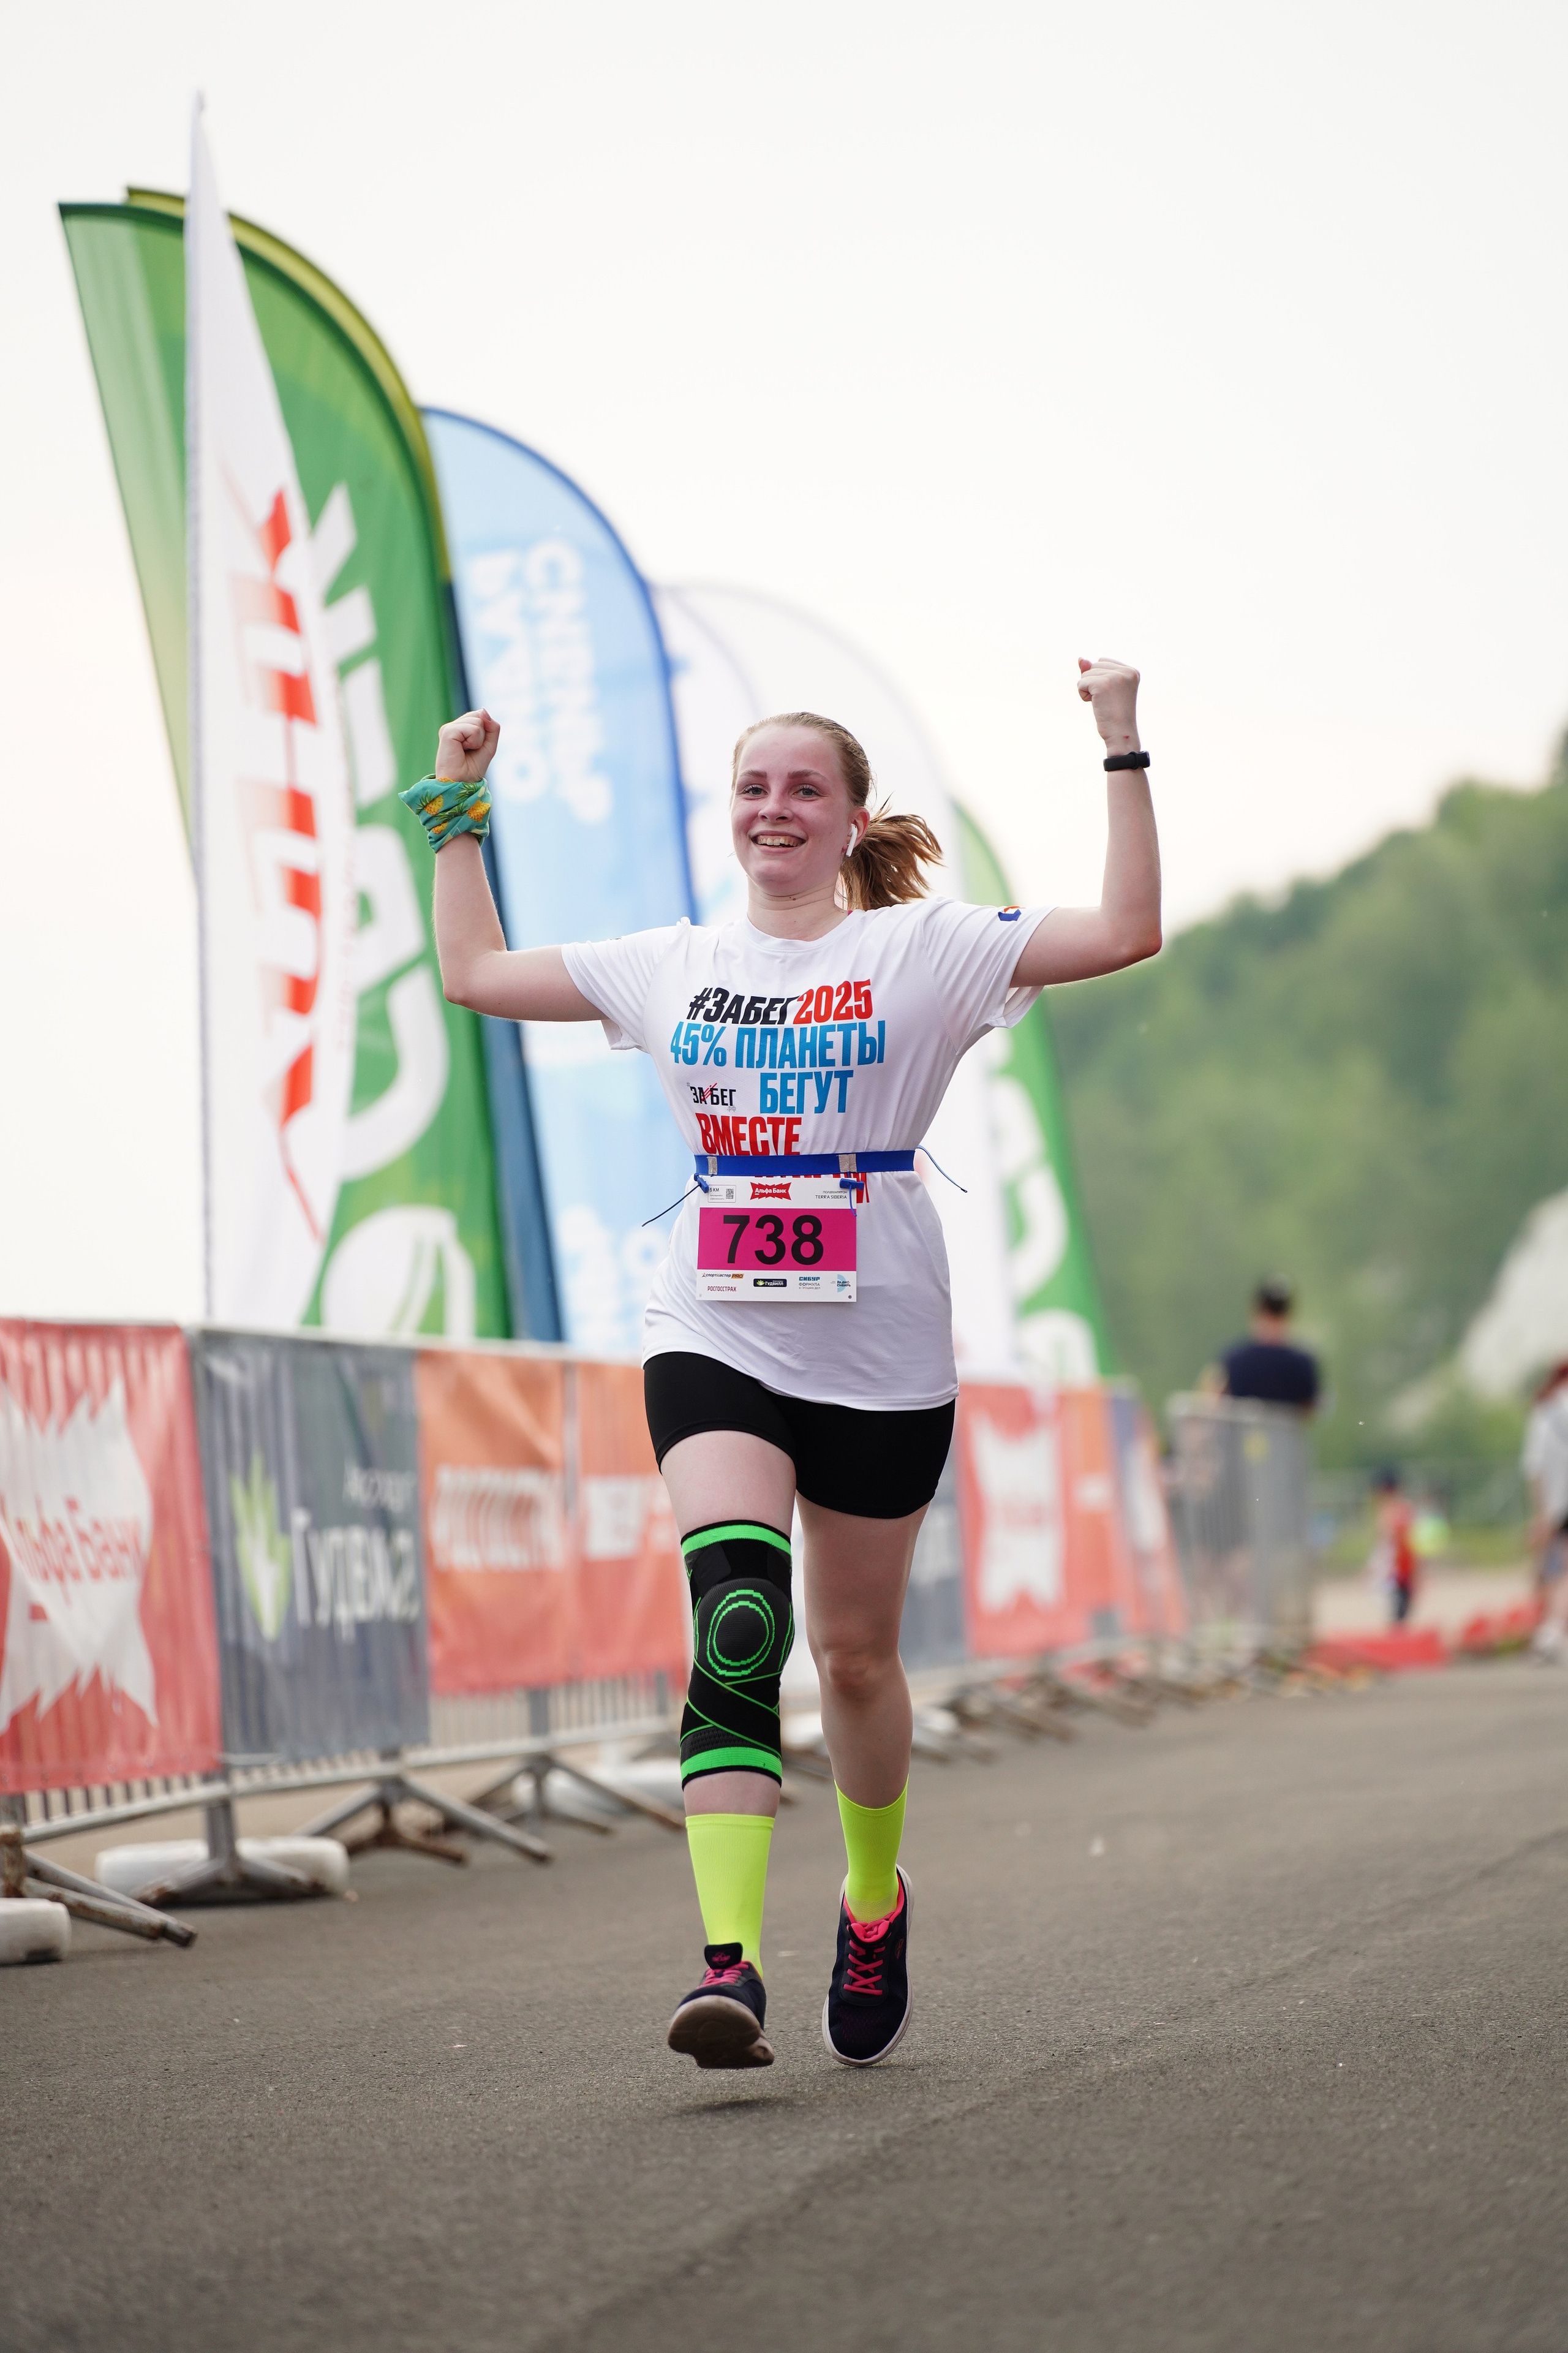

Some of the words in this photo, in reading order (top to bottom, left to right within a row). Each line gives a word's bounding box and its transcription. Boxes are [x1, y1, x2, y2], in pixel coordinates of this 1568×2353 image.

[670, 1021, 727, 1067] 45%
[735, 1021, 886, 1069] ПЛАНЕТЫ
[760, 1070, 854, 1114] БЕГУТ
[695, 1112, 802, 1155] ВМЕСТЕ
[723, 1214, 824, 1266] 738
